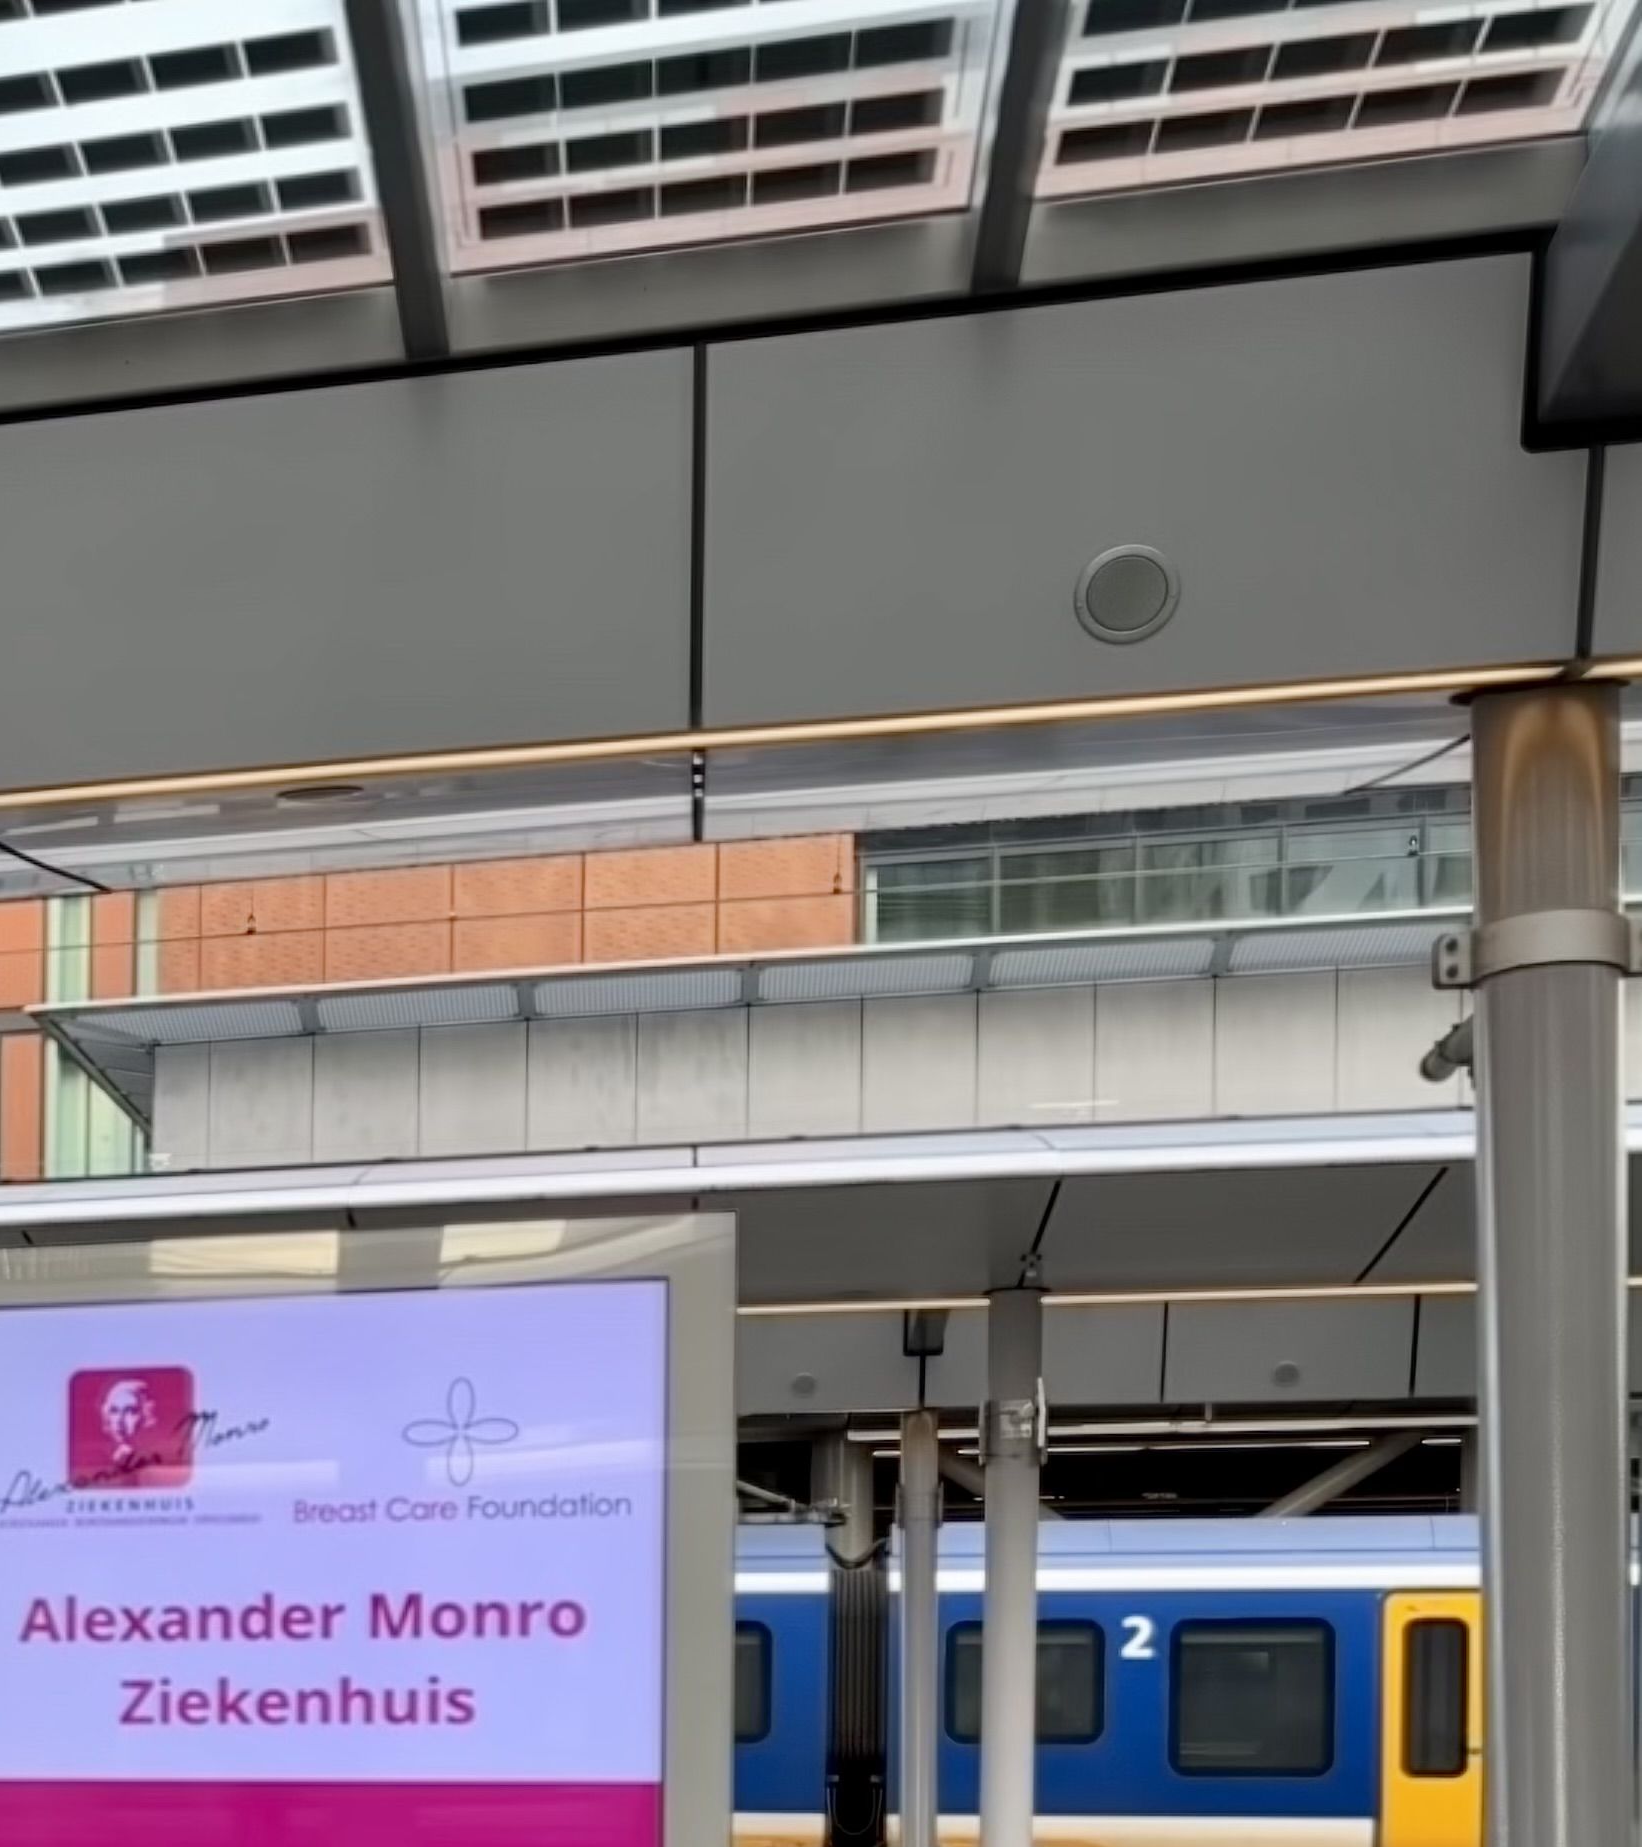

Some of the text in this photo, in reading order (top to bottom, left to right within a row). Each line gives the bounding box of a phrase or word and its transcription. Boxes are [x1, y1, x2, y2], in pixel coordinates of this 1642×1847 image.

[173, 1410, 270, 1461] Monro
[66, 1498, 194, 1514] ZIEKENHUIS
[293, 1499, 377, 1524] Breast
[386, 1497, 457, 1523] Care
[467, 1492, 631, 1519] Foundation
[19, 1592, 586, 1643] Alexander Monro
[1120, 1616, 1156, 1658] 2
[119, 1677, 476, 1726] Ziekenhuis
